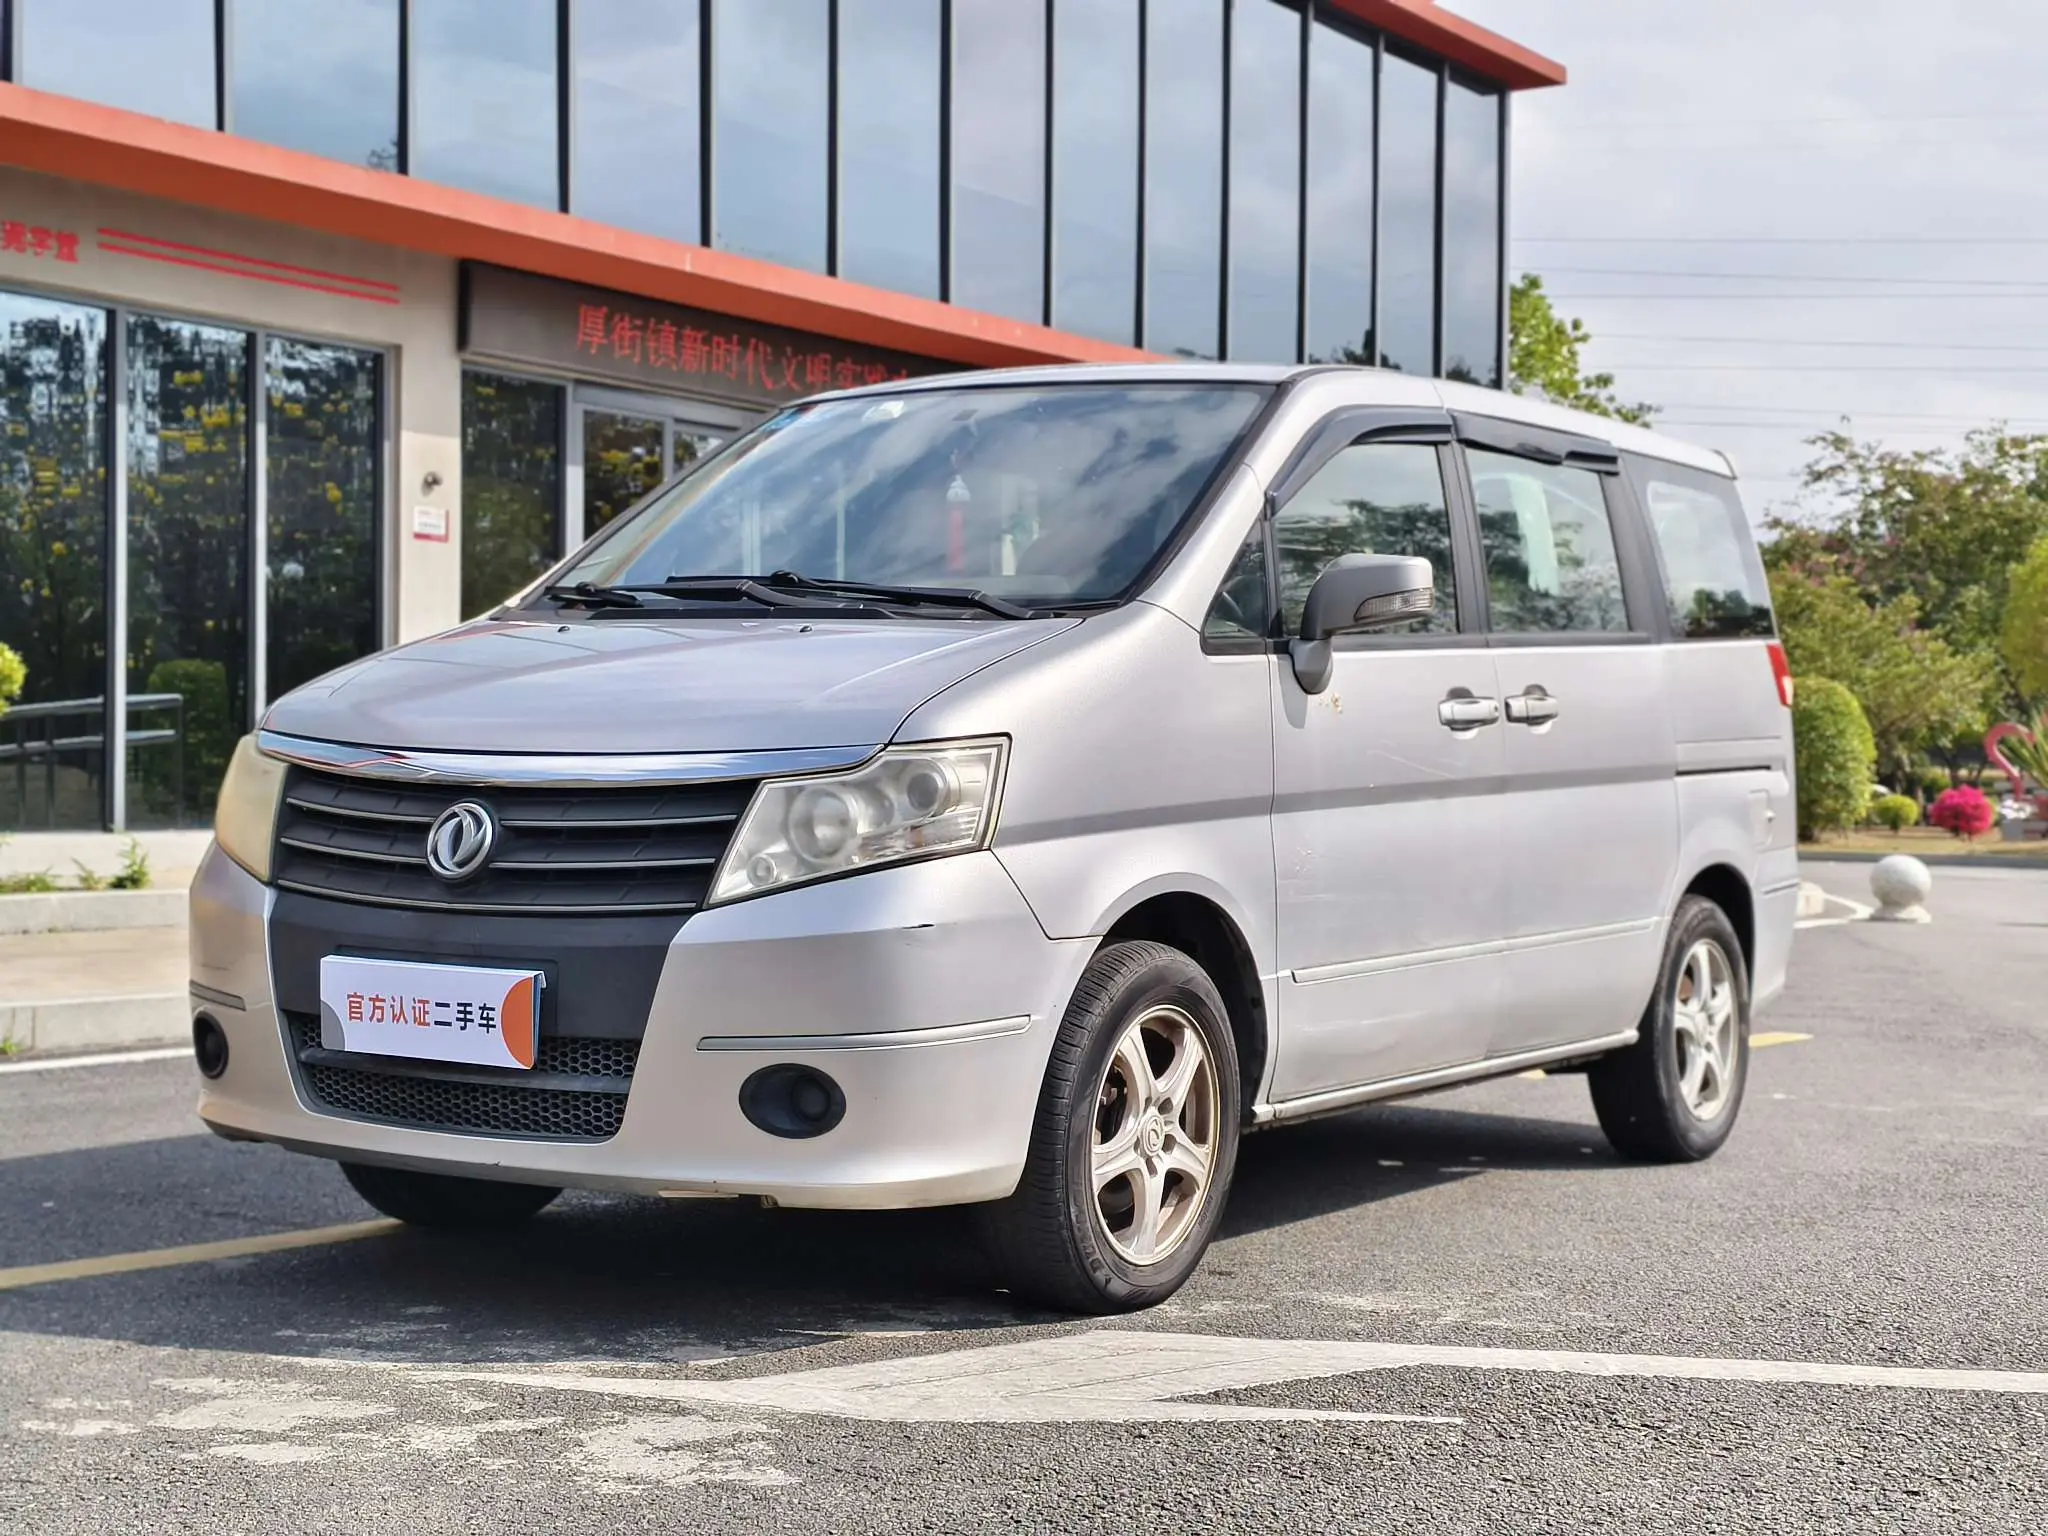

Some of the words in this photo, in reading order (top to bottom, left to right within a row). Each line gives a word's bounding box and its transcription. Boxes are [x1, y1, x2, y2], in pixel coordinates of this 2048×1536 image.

[577, 303, 907, 391] 厚街镇新时代文明实践
[347, 992, 497, 1034] 官方认证二手车
